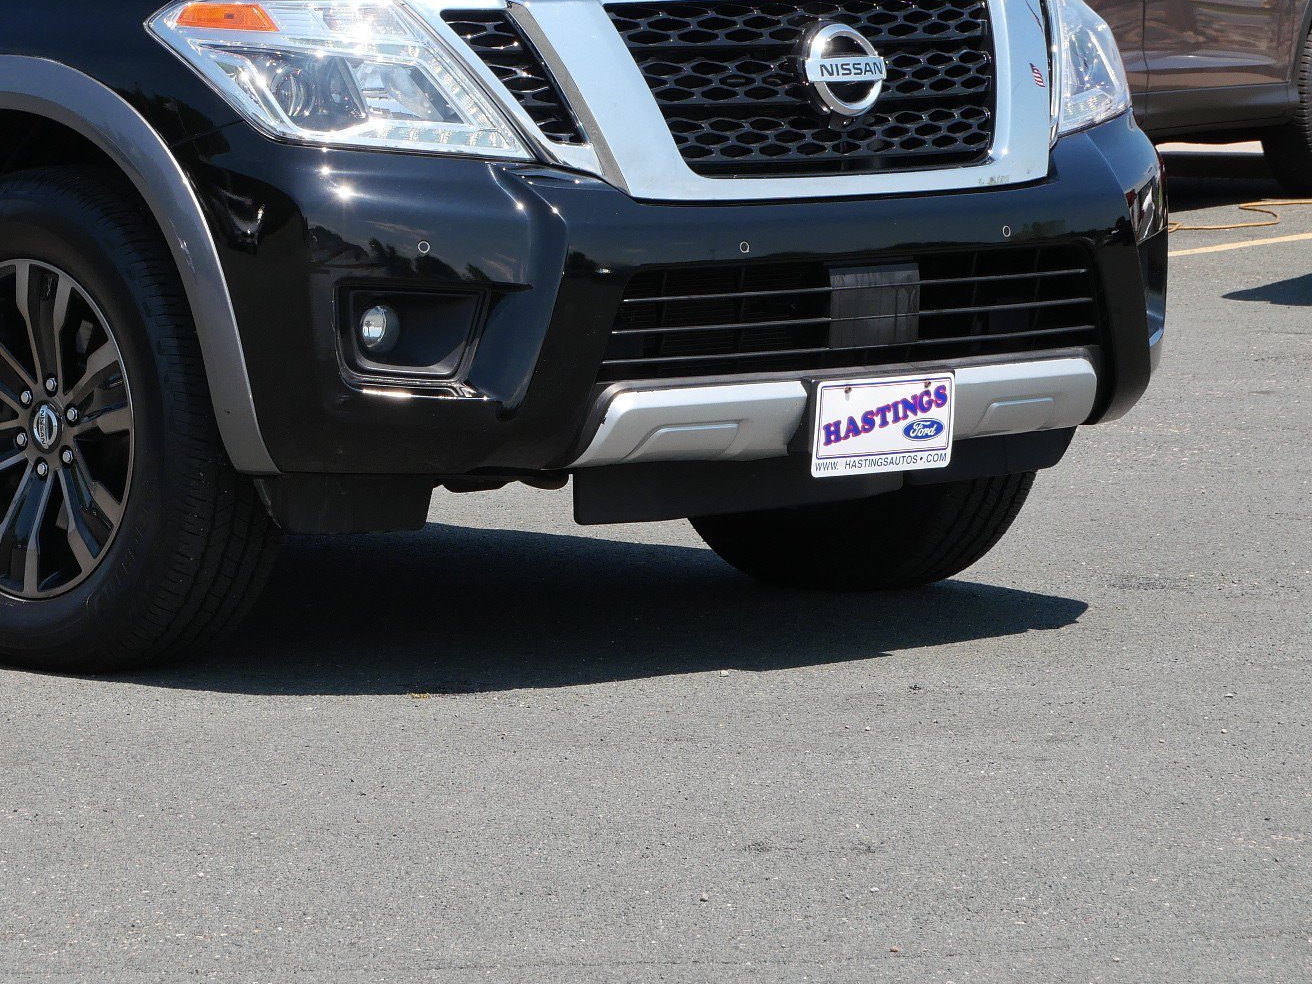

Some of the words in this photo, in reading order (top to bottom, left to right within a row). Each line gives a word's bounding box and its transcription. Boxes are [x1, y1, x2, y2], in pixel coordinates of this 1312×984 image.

[819, 62, 883, 77] NISSAN
[824, 385, 947, 446] HASTINGS
[909, 421, 937, 437] Ford
